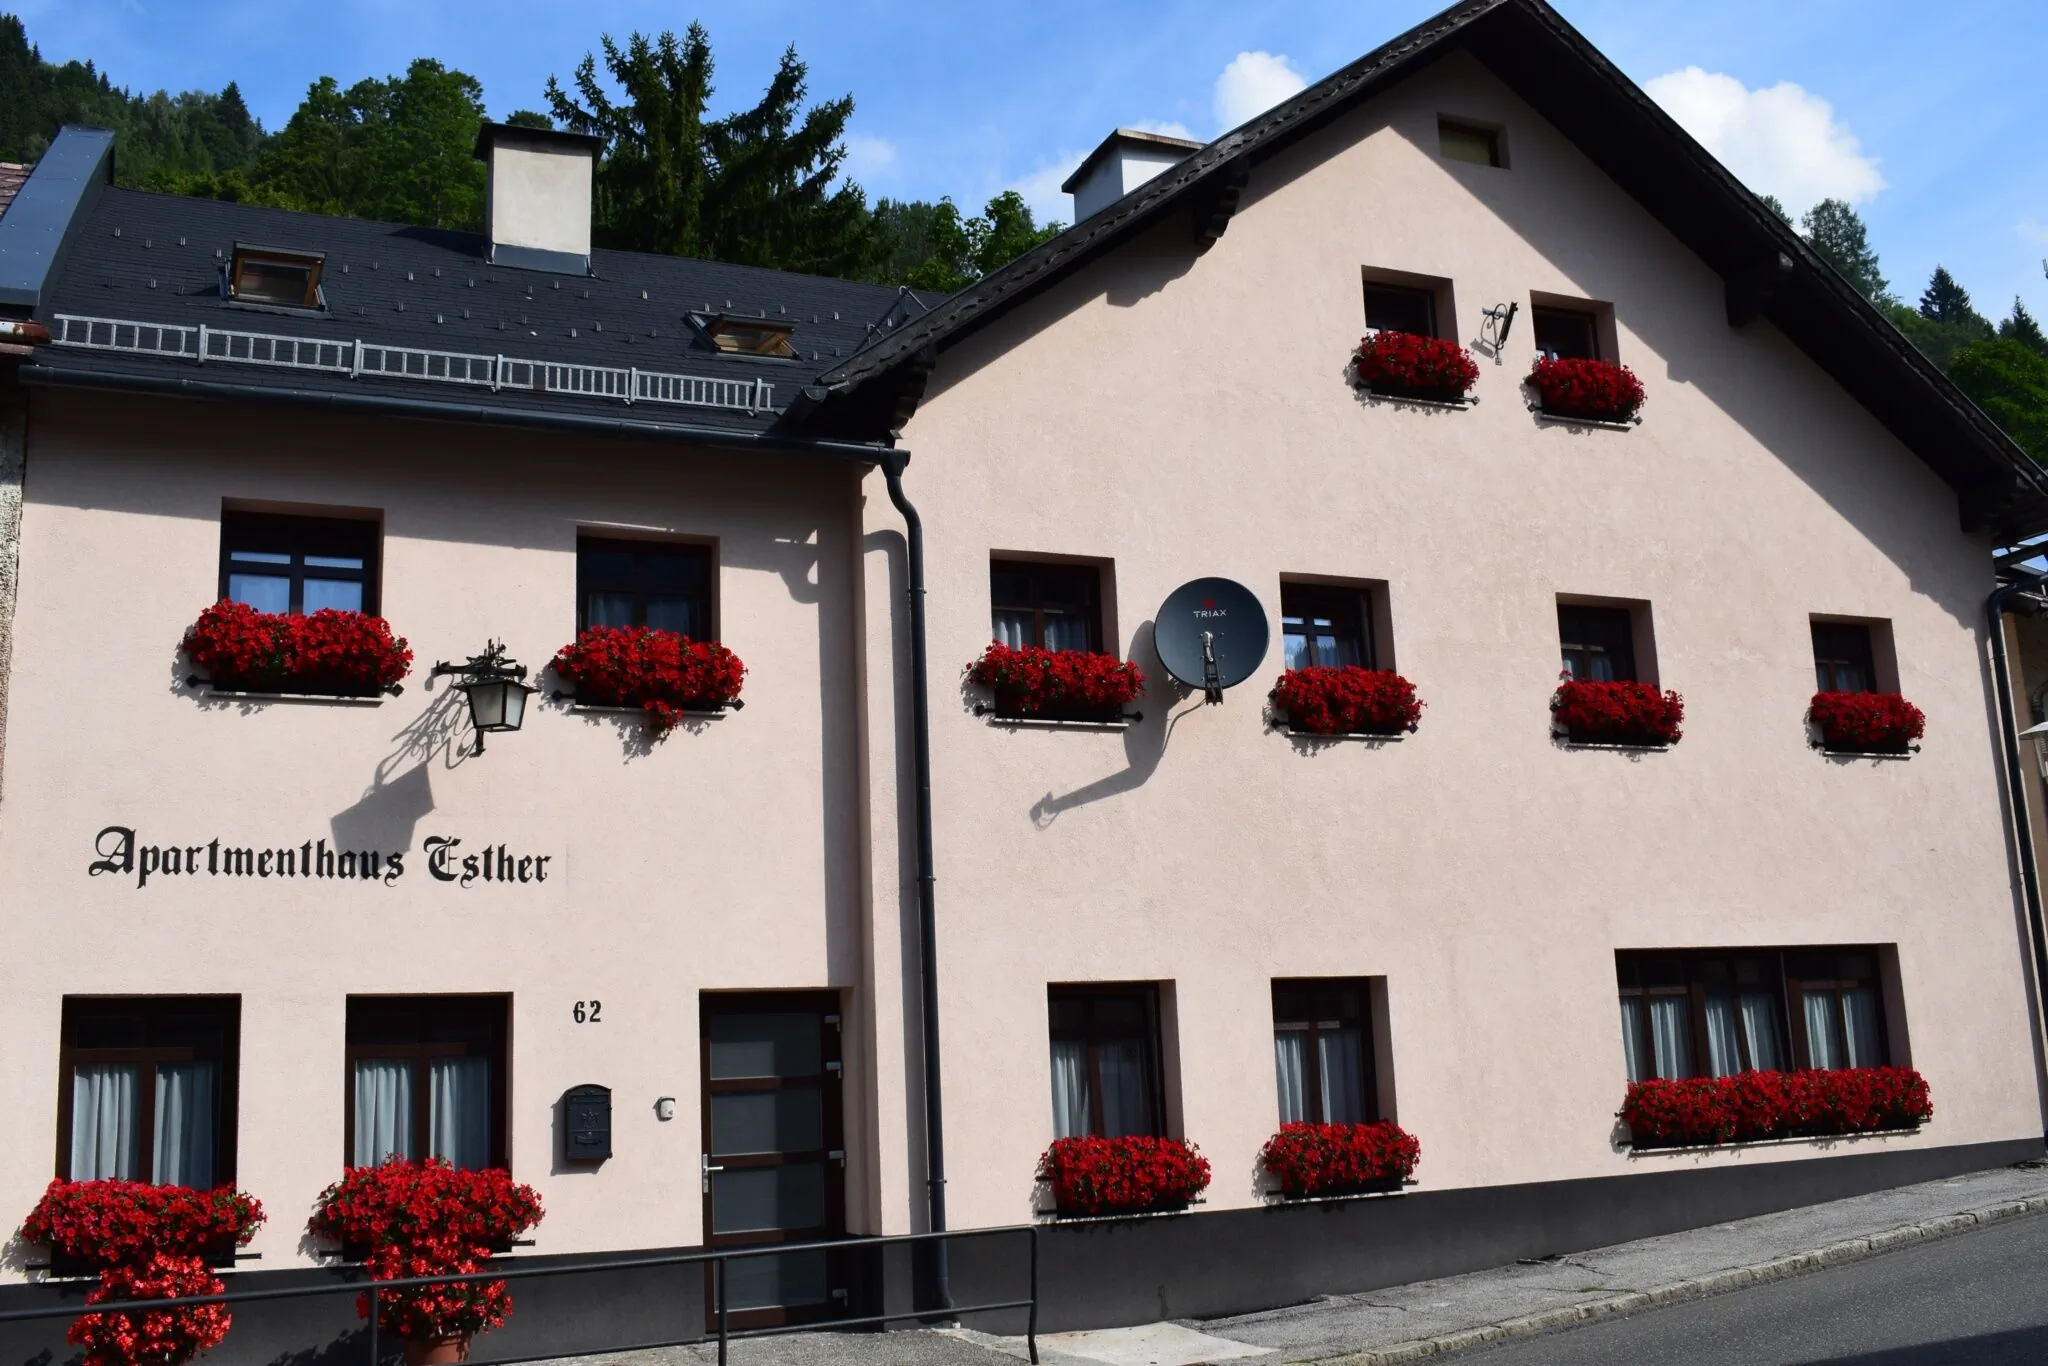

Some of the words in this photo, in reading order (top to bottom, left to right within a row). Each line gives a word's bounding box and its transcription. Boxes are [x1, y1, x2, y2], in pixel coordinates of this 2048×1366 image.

[1193, 609, 1227, 618] TRIAX
[88, 826, 405, 889] Apartmenthaus
[423, 835, 553, 889] Esther
[573, 1000, 602, 1023] 62
